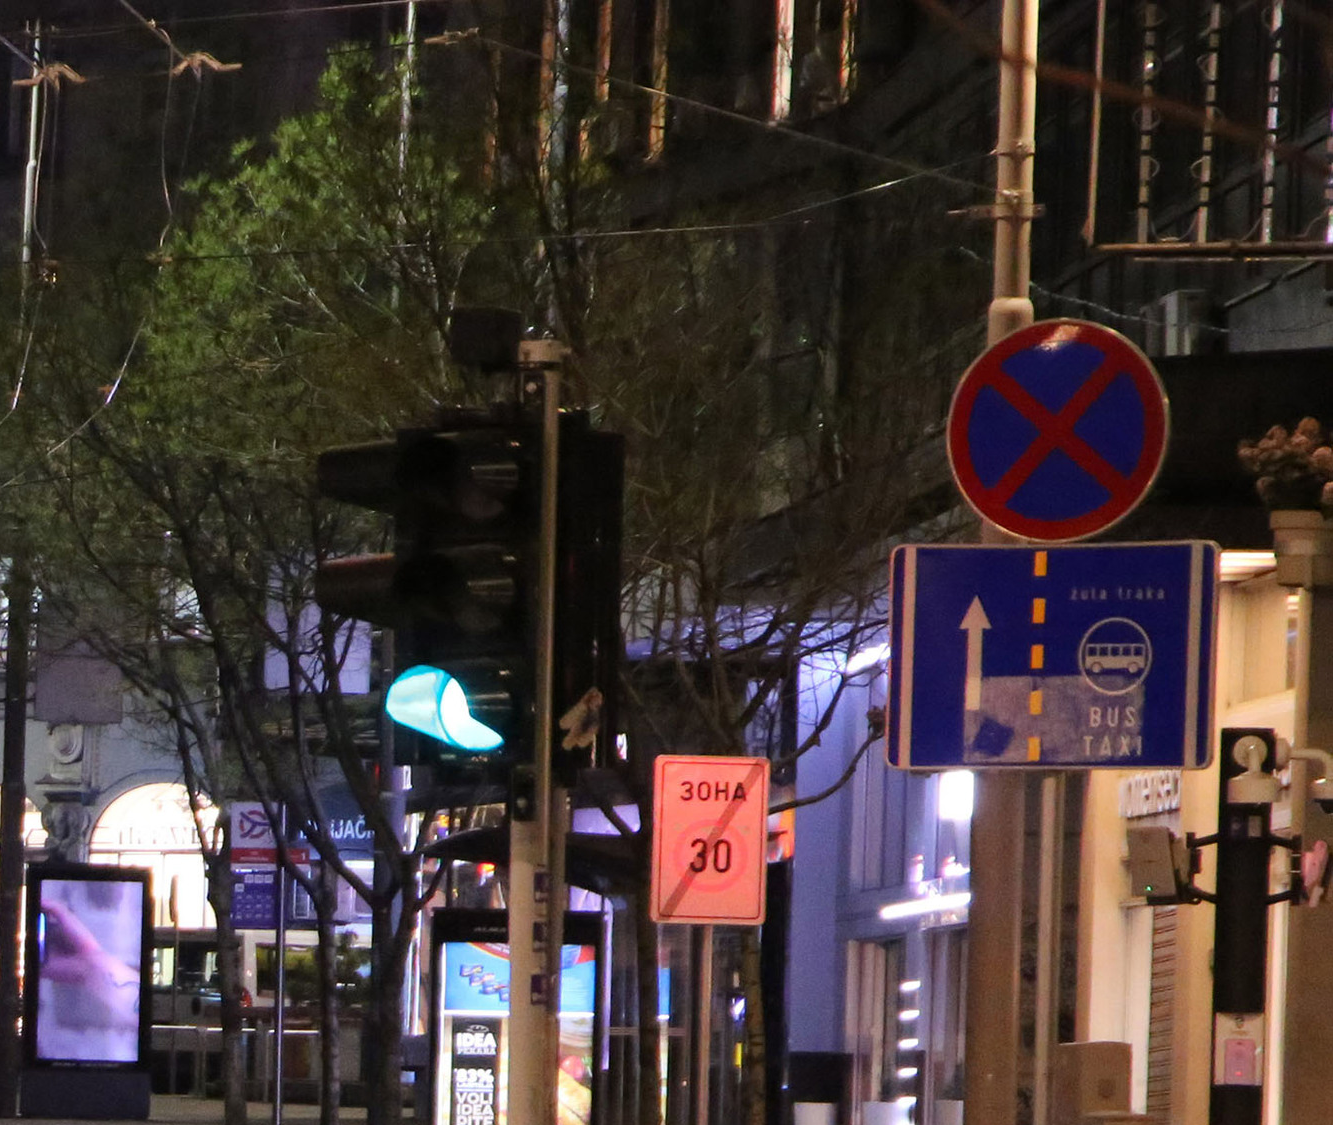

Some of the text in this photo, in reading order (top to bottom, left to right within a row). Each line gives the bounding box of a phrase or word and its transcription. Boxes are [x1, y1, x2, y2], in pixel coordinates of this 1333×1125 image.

[1089, 706, 1137, 728] BUS
[1082, 735, 1142, 757] TAXI
[679, 780, 748, 802] ЗОНА
[689, 837, 732, 874] 30
[456, 1032, 497, 1048] IDEA
[455, 1092, 493, 1105] VOLI
[456, 1104, 494, 1116] IDEA
